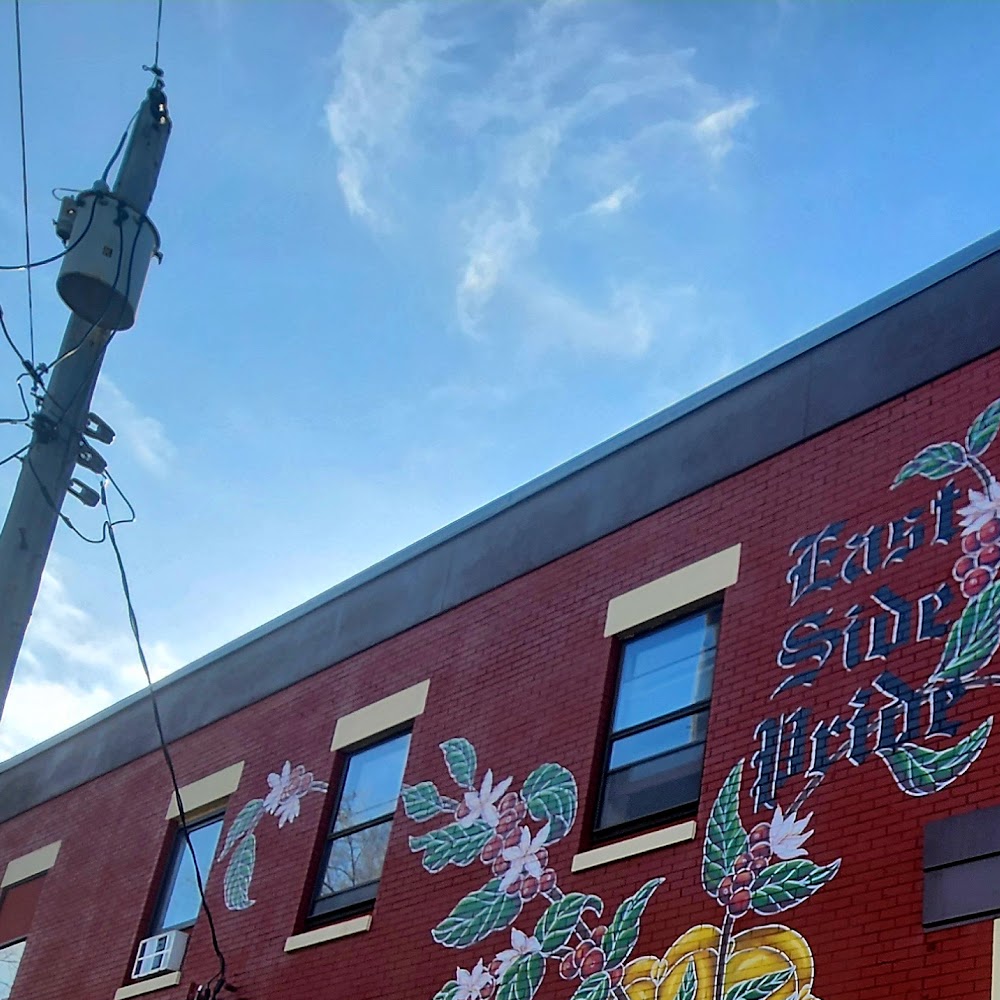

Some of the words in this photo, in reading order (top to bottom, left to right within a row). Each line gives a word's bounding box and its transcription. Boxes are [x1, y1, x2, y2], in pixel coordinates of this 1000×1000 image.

[786, 478, 964, 607] East
[769, 584, 953, 700] Side
[750, 670, 965, 814] Pride
